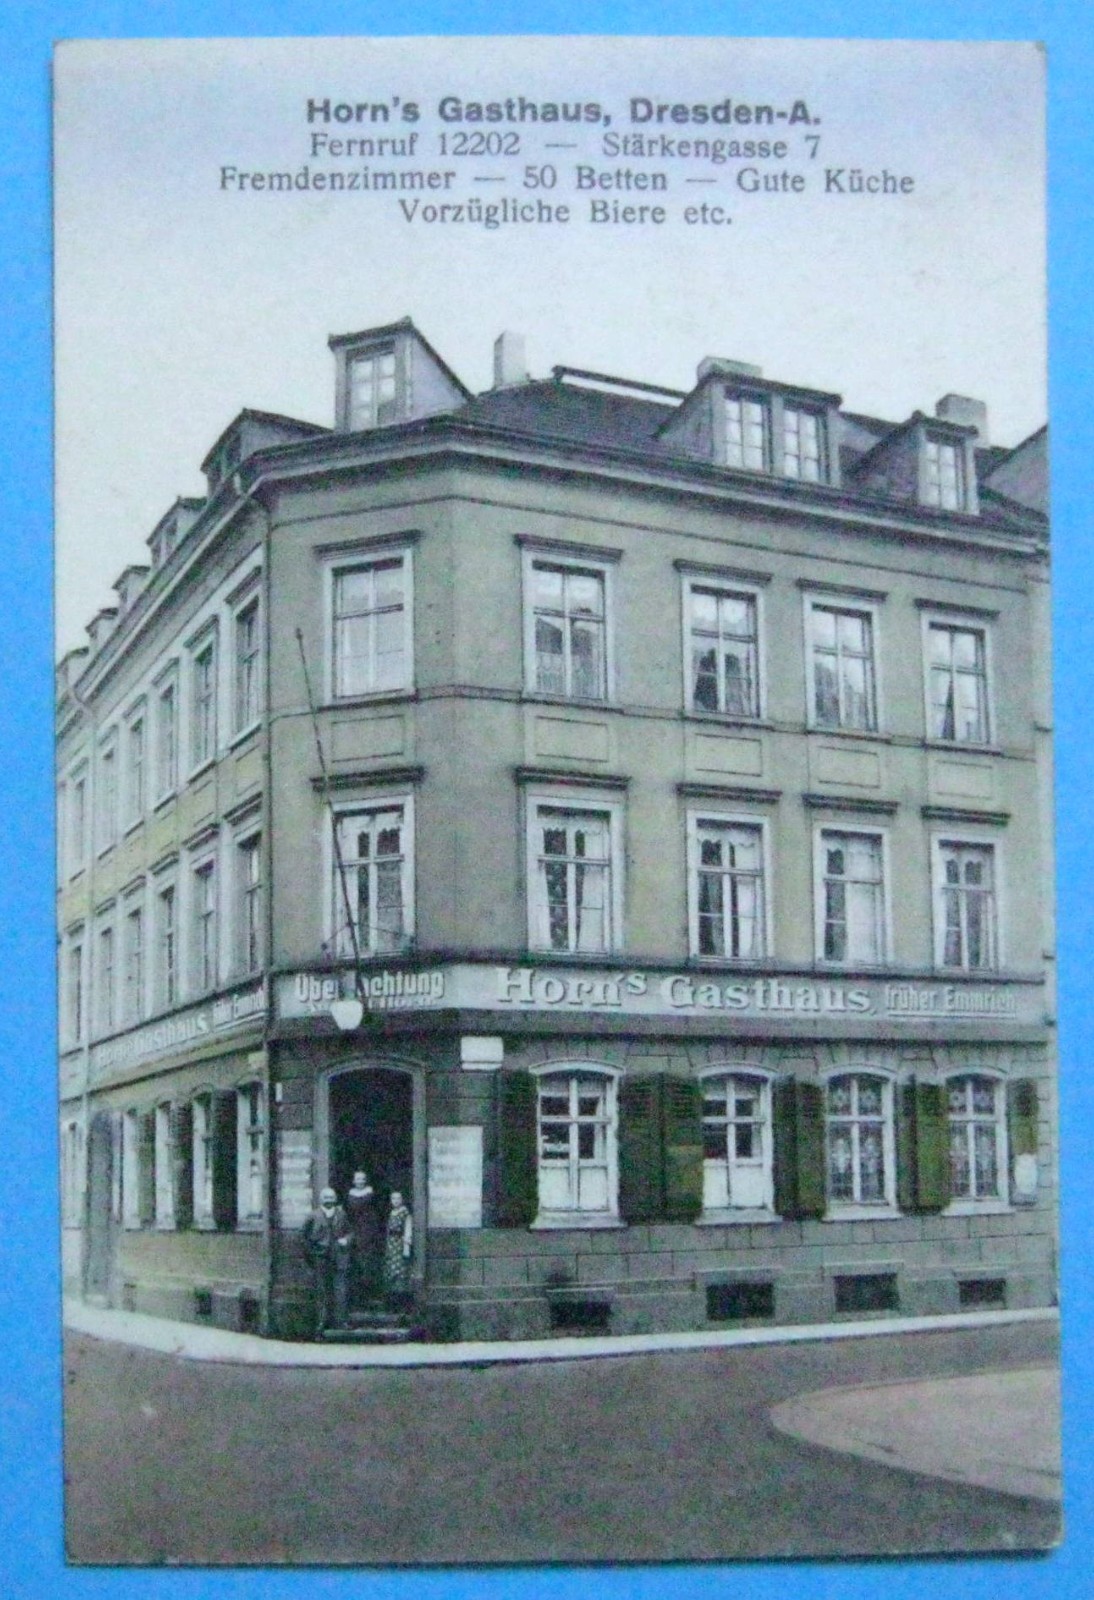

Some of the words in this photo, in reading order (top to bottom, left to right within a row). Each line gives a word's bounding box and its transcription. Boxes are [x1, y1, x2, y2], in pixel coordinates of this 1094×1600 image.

[306, 97, 420, 124] Horn's
[437, 97, 612, 127] Gasthaus,
[629, 98, 822, 126] Dresden-A.
[310, 132, 419, 157] Fernruf
[439, 132, 521, 157] 12202
[602, 132, 788, 160] Stärkengasse
[804, 135, 821, 160] 7
[219, 165, 457, 192] Fremdenzimmer
[522, 165, 558, 191] 50
[575, 166, 668, 192] Betten
[736, 168, 806, 194] Gute
[824, 168, 915, 195] Küche
[398, 198, 570, 230] Vorzügliche
[590, 200, 666, 225] Biere
[683, 203, 733, 226] etc.
[496, 966, 648, 1007] Horn's
